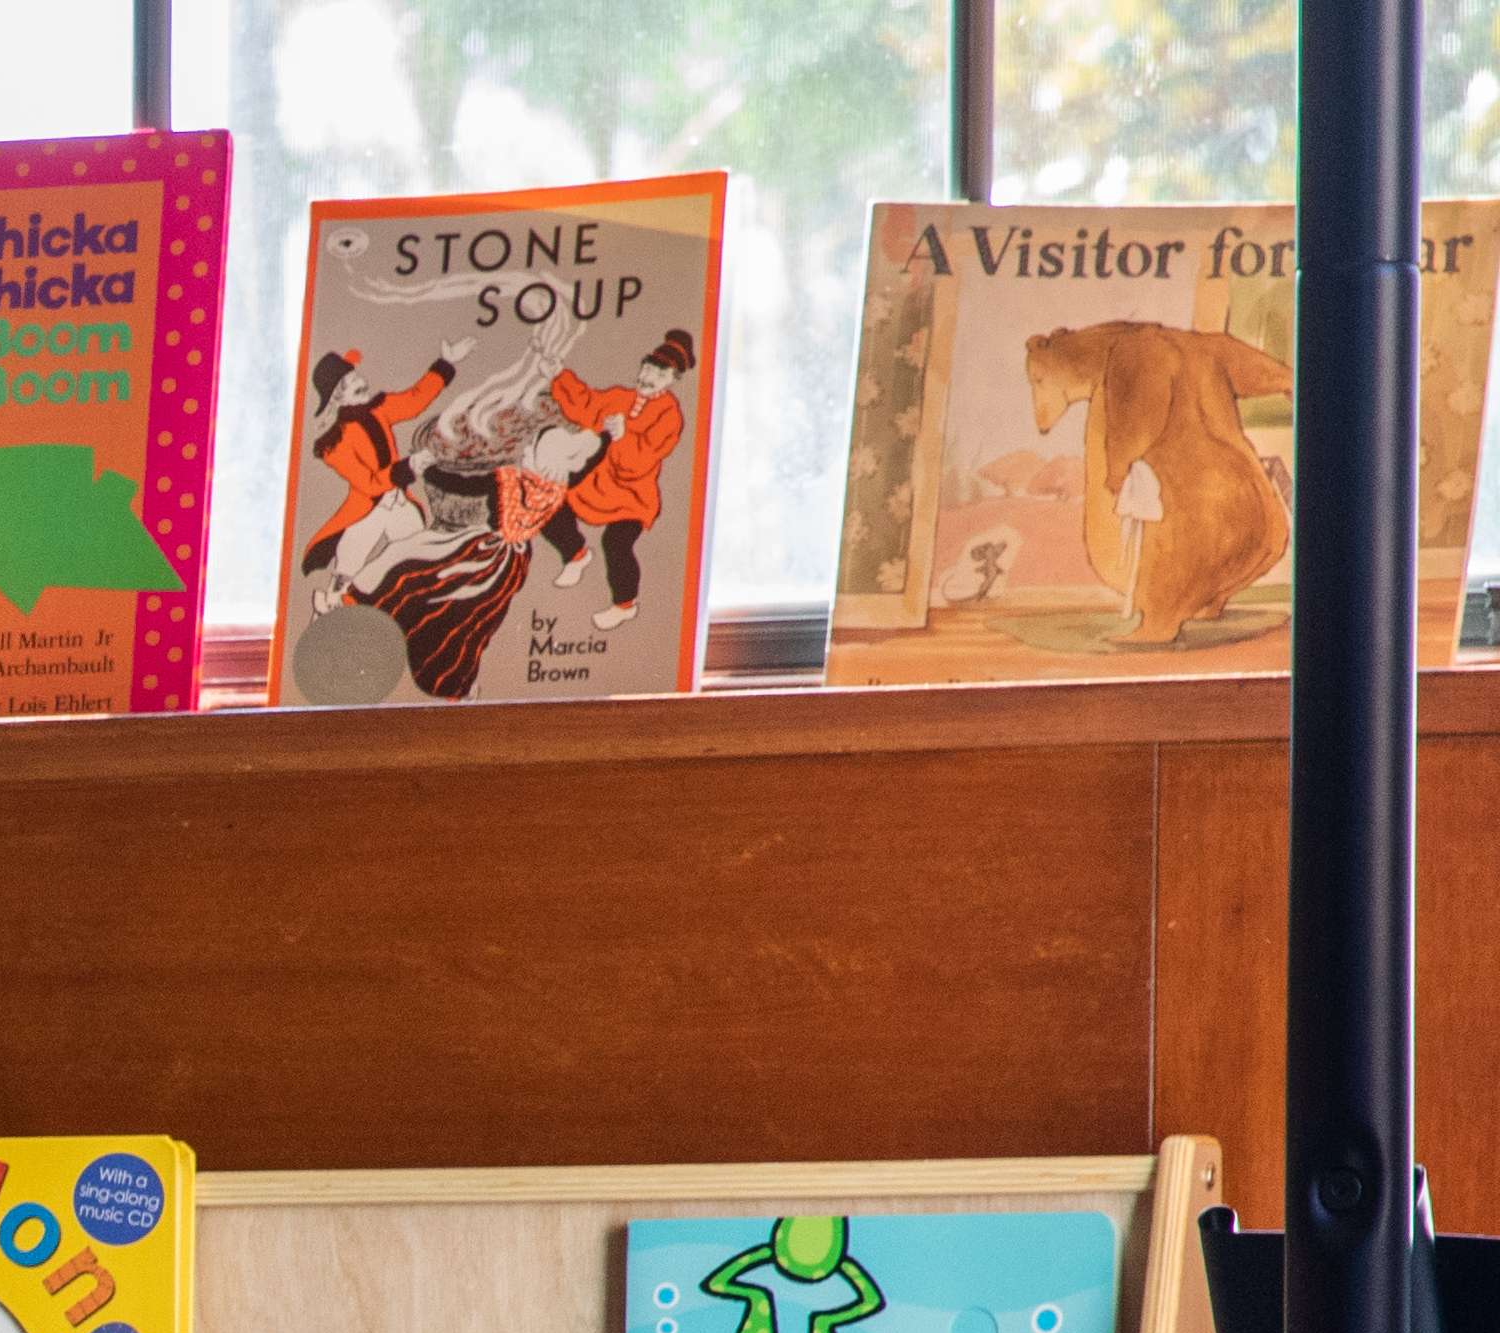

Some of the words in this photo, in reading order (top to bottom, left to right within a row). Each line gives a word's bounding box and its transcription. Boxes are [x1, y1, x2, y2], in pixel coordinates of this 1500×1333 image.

[395, 222, 600, 276] STONE
[901, 223, 953, 276] A
[968, 225, 1187, 280] Visitor
[1206, 226, 1296, 280] for
[476, 276, 643, 327] SOUP
[530, 608, 558, 636] by
[19, 630, 83, 650] Martin
[94, 629, 114, 647] Jr
[528, 634, 608, 657] Marcia
[527, 660, 591, 684] Brown
[8, 696, 48, 713] Lois
[55, 693, 112, 712] Ehlert
[99, 1166, 133, 1186] With
[135, 1175, 149, 1189] a
[79, 1182, 160, 1212] sing-along
[79, 1204, 125, 1224] music
[127, 1209, 154, 1228] CD
